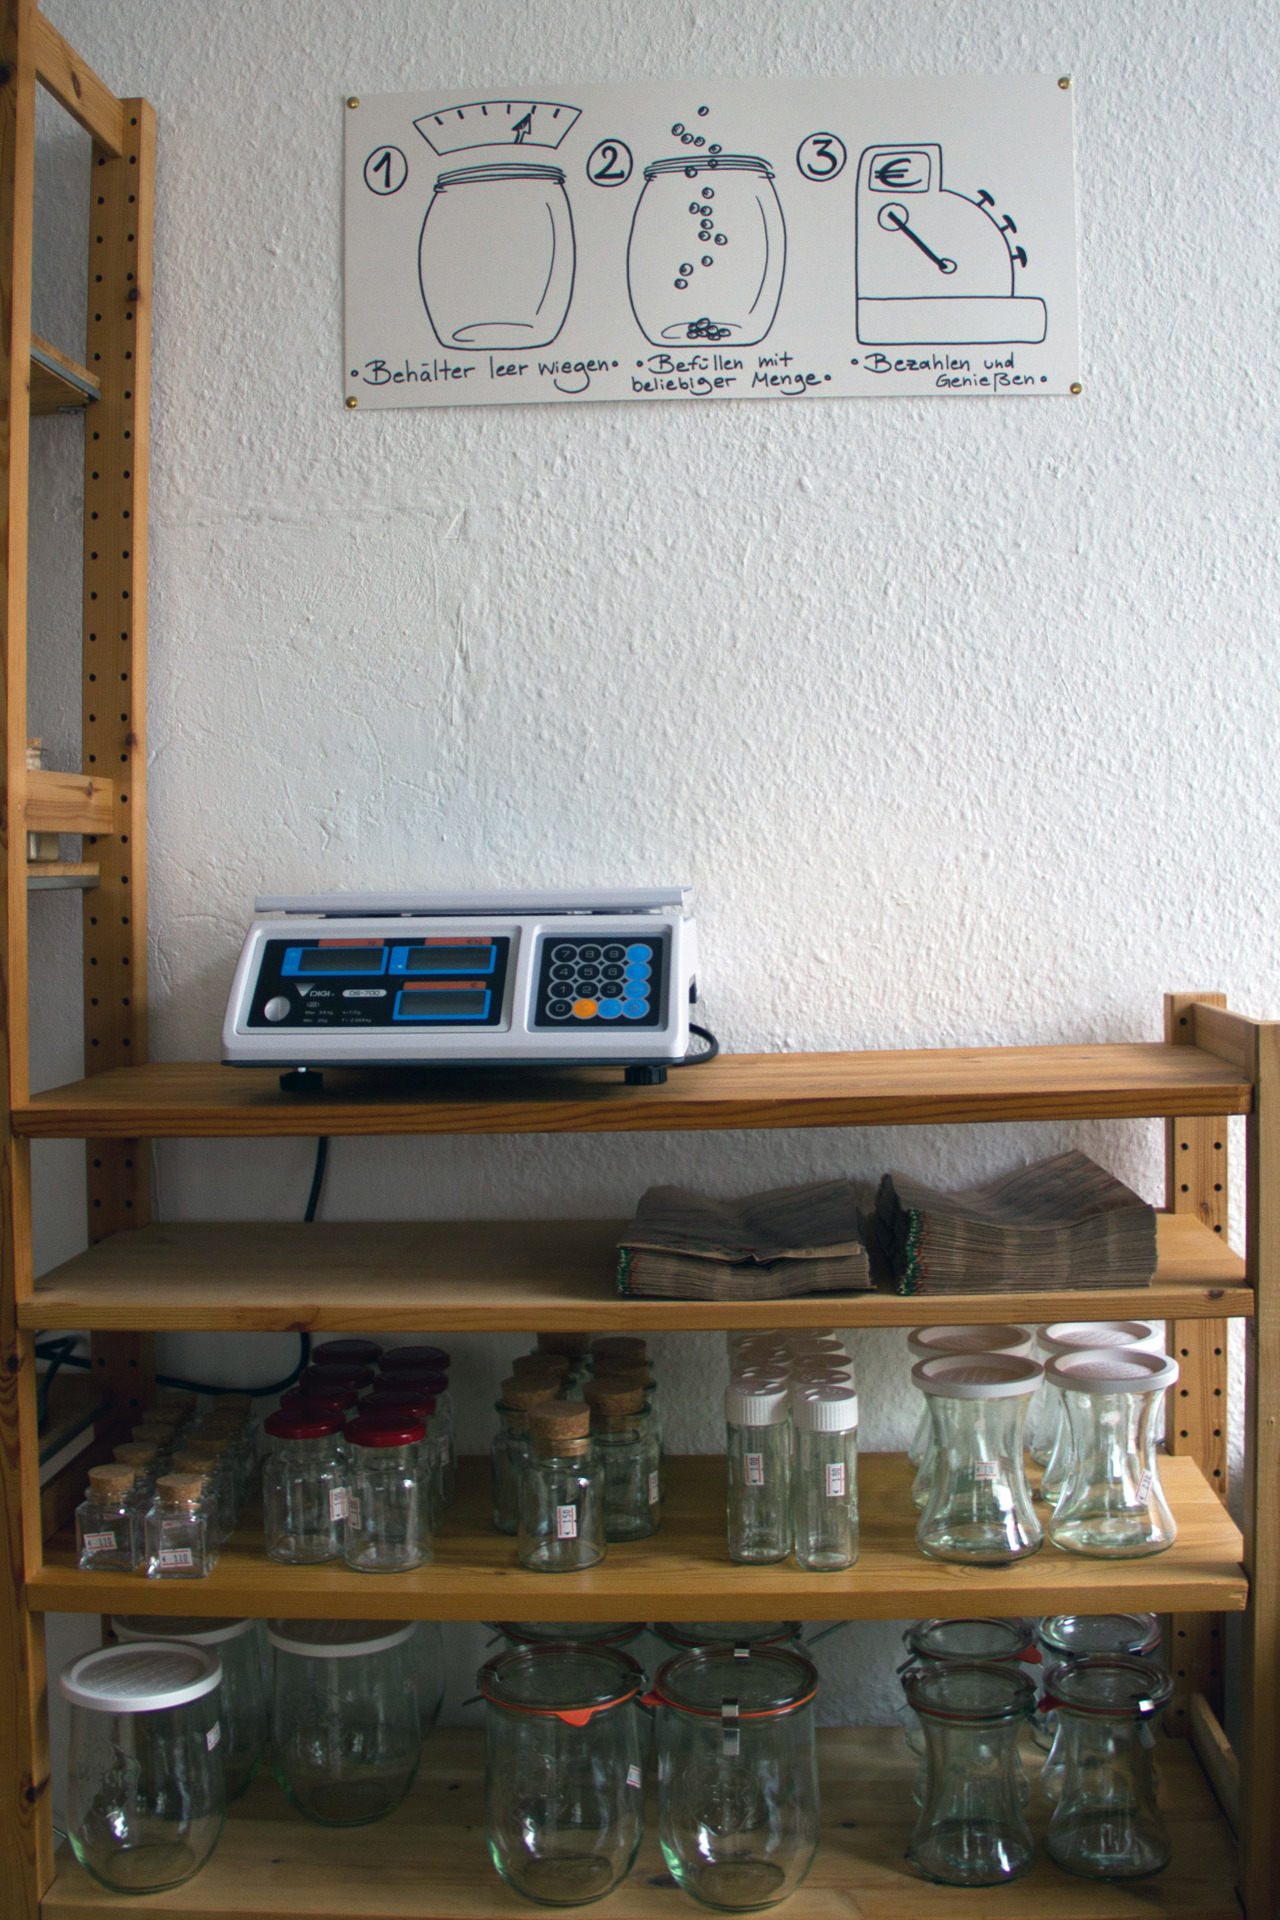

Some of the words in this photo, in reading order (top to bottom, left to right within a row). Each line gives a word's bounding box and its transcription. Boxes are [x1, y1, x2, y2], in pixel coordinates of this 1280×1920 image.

[592, 147, 626, 180] 2
[805, 138, 838, 178] 3
[874, 157, 922, 188] €
[362, 359, 476, 385] Behälter
[489, 355, 529, 379] leer
[647, 353, 744, 374] Befüllen
[758, 351, 793, 367] mit
[863, 352, 970, 373] Bezahlen
[983, 352, 1015, 370] und
[631, 374, 737, 396] beliebiger
[751, 371, 822, 396] Menge
[935, 373, 1035, 392] Genießen
